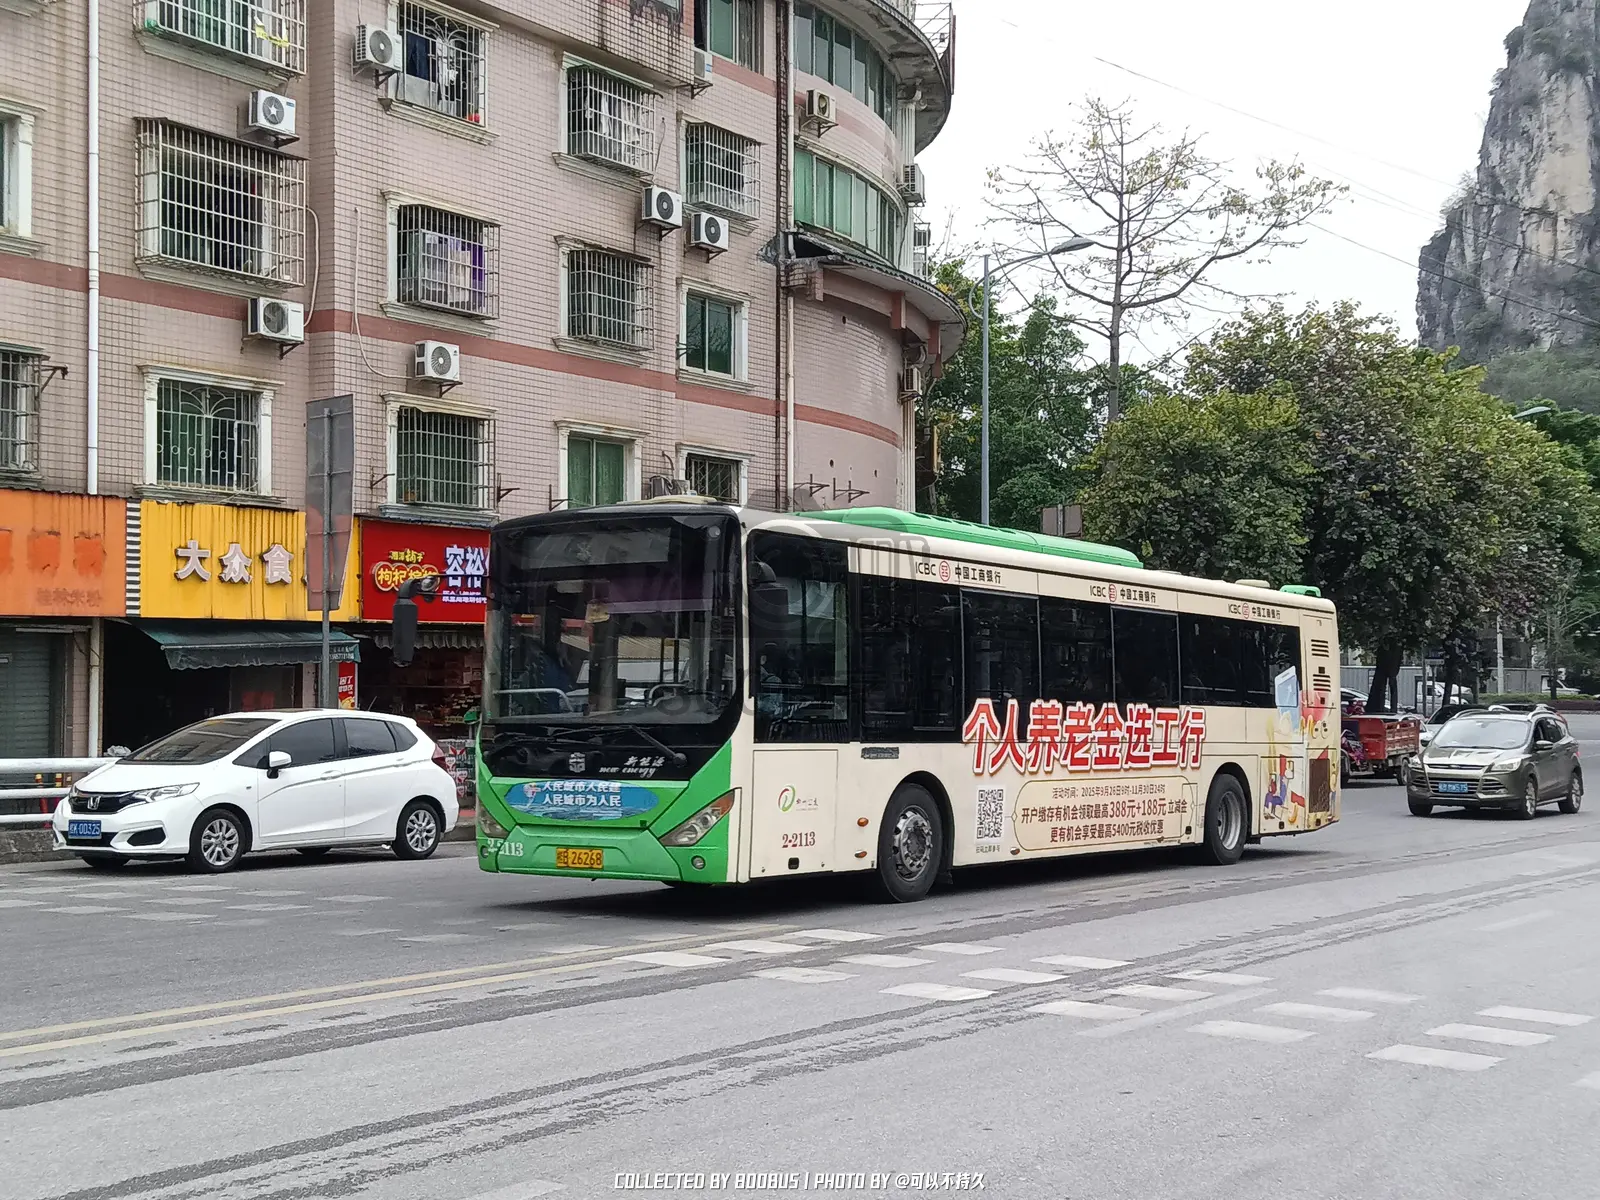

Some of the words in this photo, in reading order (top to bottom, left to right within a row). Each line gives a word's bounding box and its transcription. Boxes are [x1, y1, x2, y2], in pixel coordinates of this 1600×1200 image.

[175, 539, 308, 586] 大众食
[445, 544, 489, 588] 容裕
[915, 562, 937, 577] ICBC
[954, 566, 1002, 584] 中国工商银行
[1090, 584, 1107, 599] ICBC
[1120, 588, 1156, 604] 中国工商银行
[1227, 603, 1241, 615] ICBC
[1251, 606, 1281, 620] 中国工商银行
[963, 697, 1207, 774] 个人养老金选工行
[624, 755, 665, 767] 新能源
[622, 766, 657, 778] energy
[542, 781, 621, 793] 人民城市人民建
[542, 793, 622, 807] 人民城市为人民
[1050, 819, 1164, 843] 更有机会享受最高5400元税收优惠
